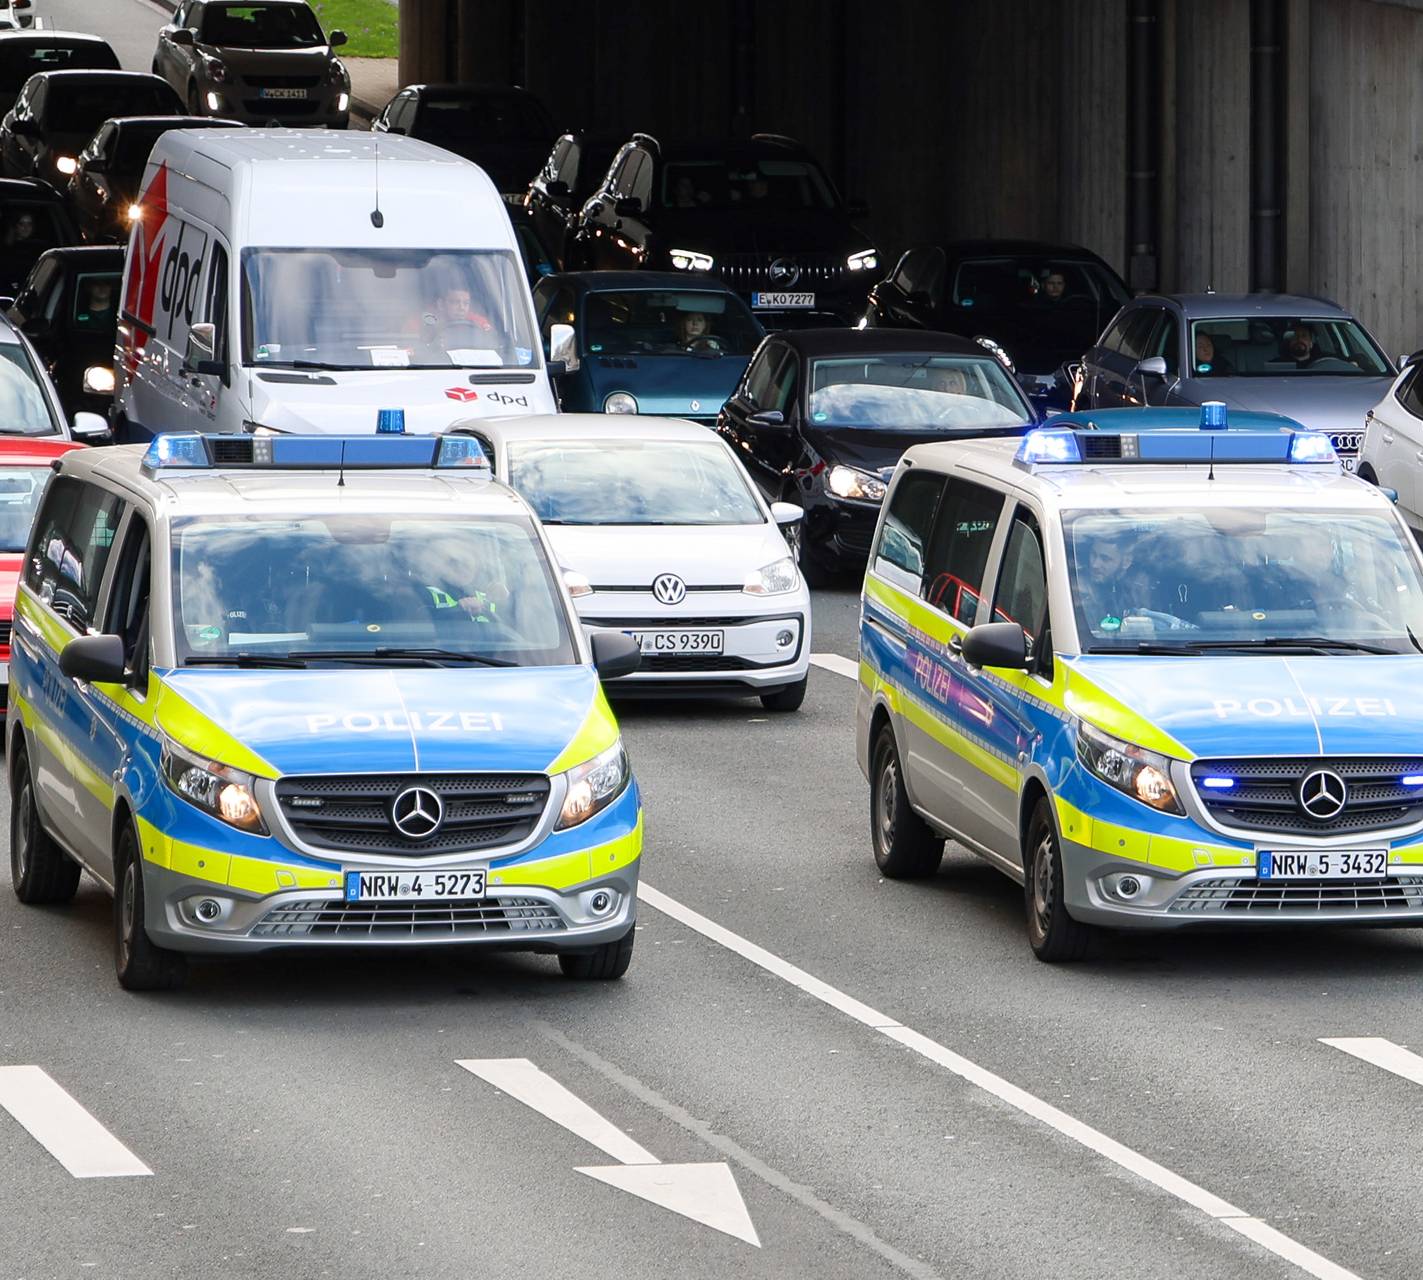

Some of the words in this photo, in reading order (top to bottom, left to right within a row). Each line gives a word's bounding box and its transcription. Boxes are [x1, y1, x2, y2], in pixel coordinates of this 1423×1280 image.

[161, 246, 202, 341] dpd
[760, 294, 766, 305] E
[772, 294, 787, 305] KO
[788, 294, 813, 305] 7277
[487, 391, 528, 407] dpd
[655, 634, 676, 650] CS
[680, 634, 720, 650] 9390
[915, 651, 951, 705] POLIZEI
[1213, 697, 1397, 719] POLIZEI
[304, 711, 504, 734] POLIZEI
[1271, 855, 1308, 875] NRW
[1319, 853, 1385, 875] 5-3432
[360, 875, 399, 897] NRW
[411, 873, 484, 896] 4-5273
